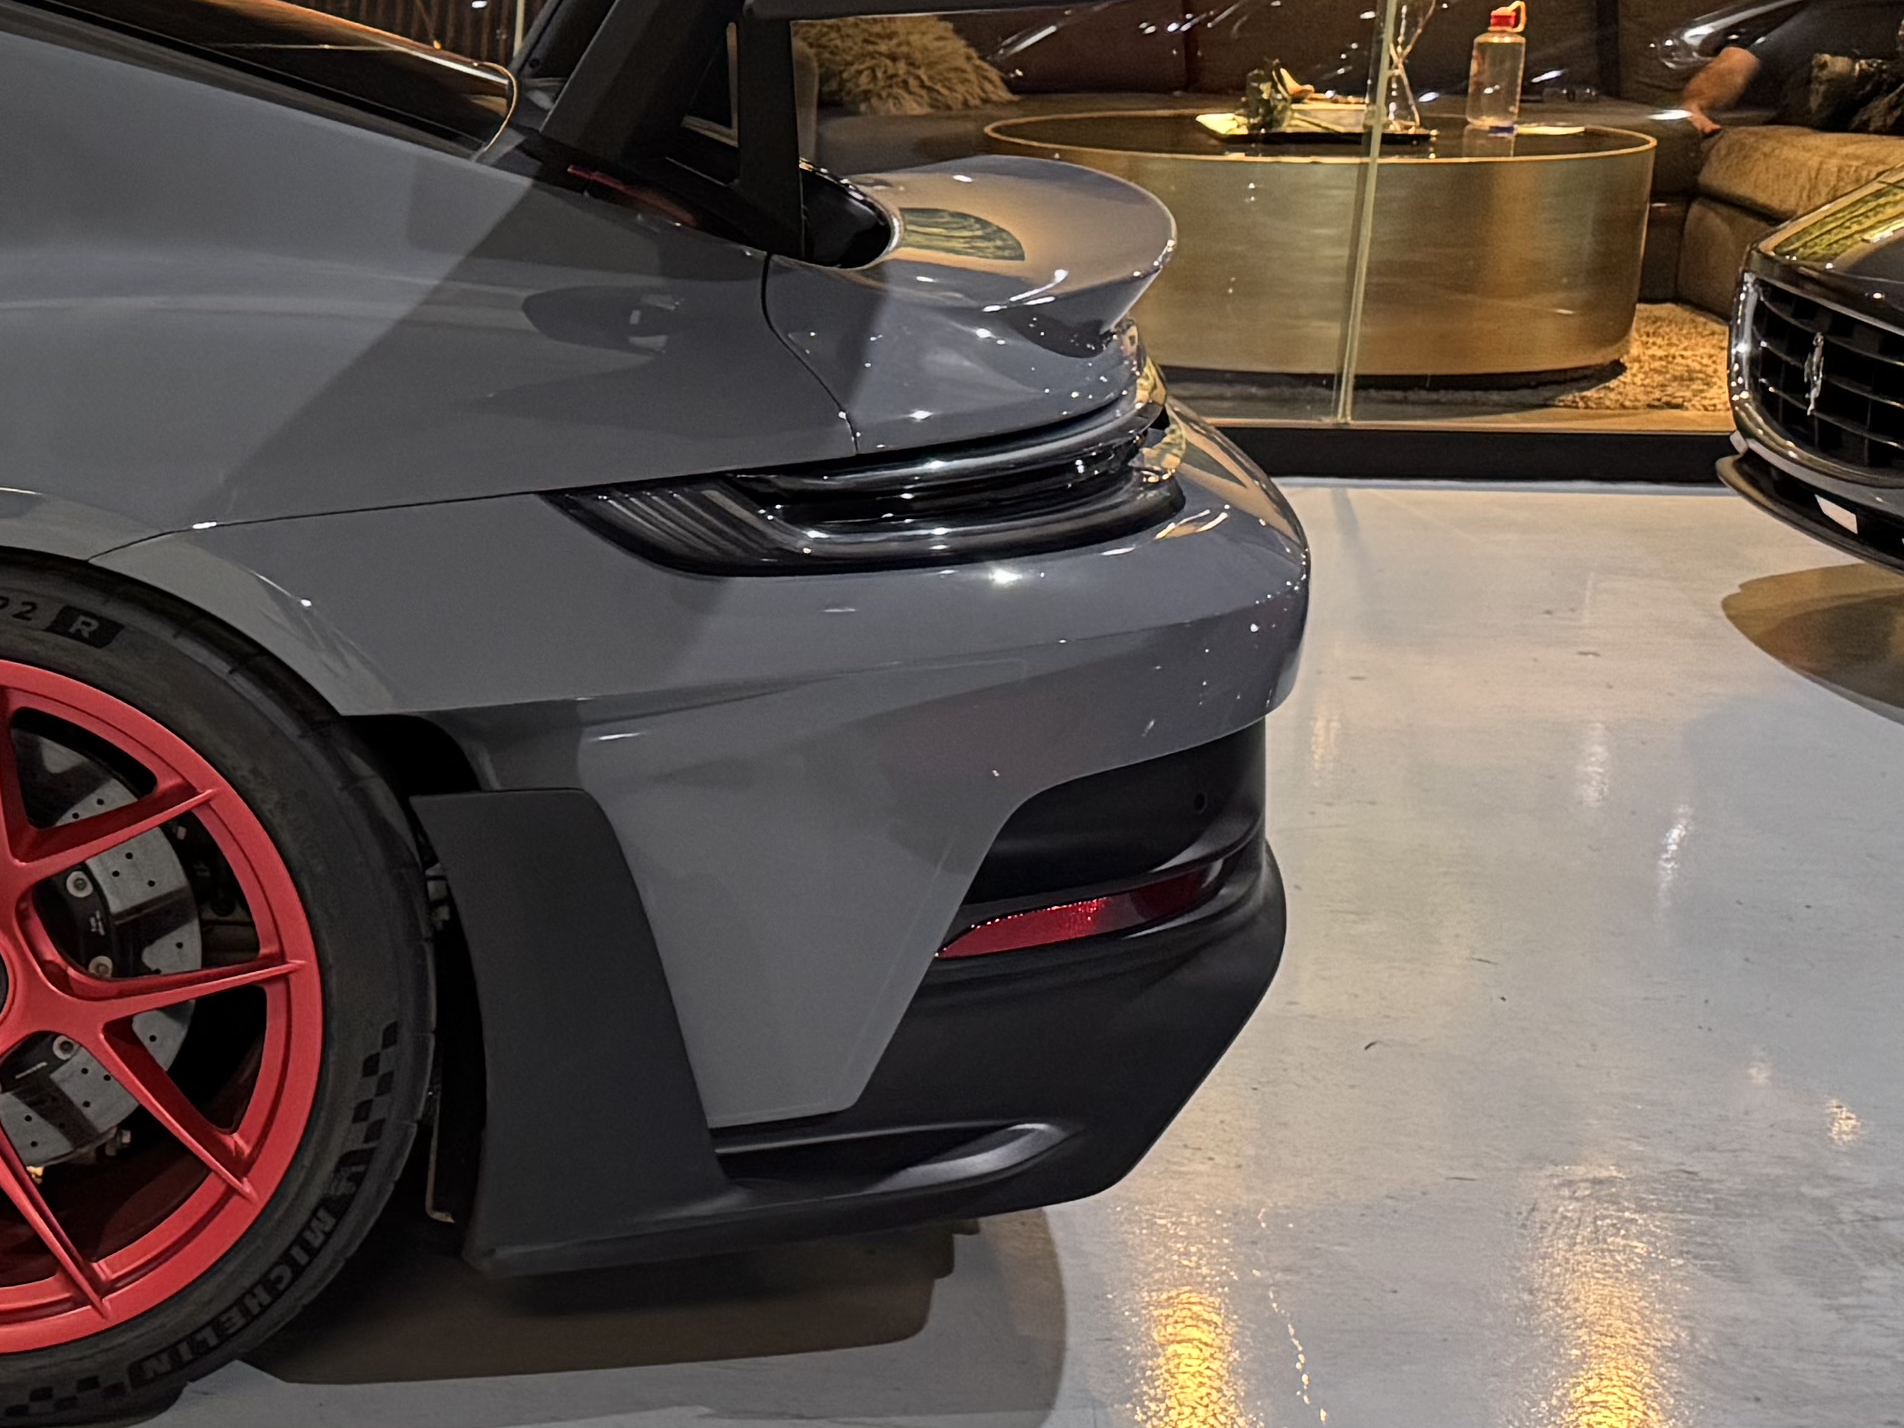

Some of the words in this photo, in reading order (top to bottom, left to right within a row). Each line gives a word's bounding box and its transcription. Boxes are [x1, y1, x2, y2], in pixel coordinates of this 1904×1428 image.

[12, 601, 38, 621] 2
[67, 614, 100, 640] R
[141, 1207, 338, 1376] MICHELIN
